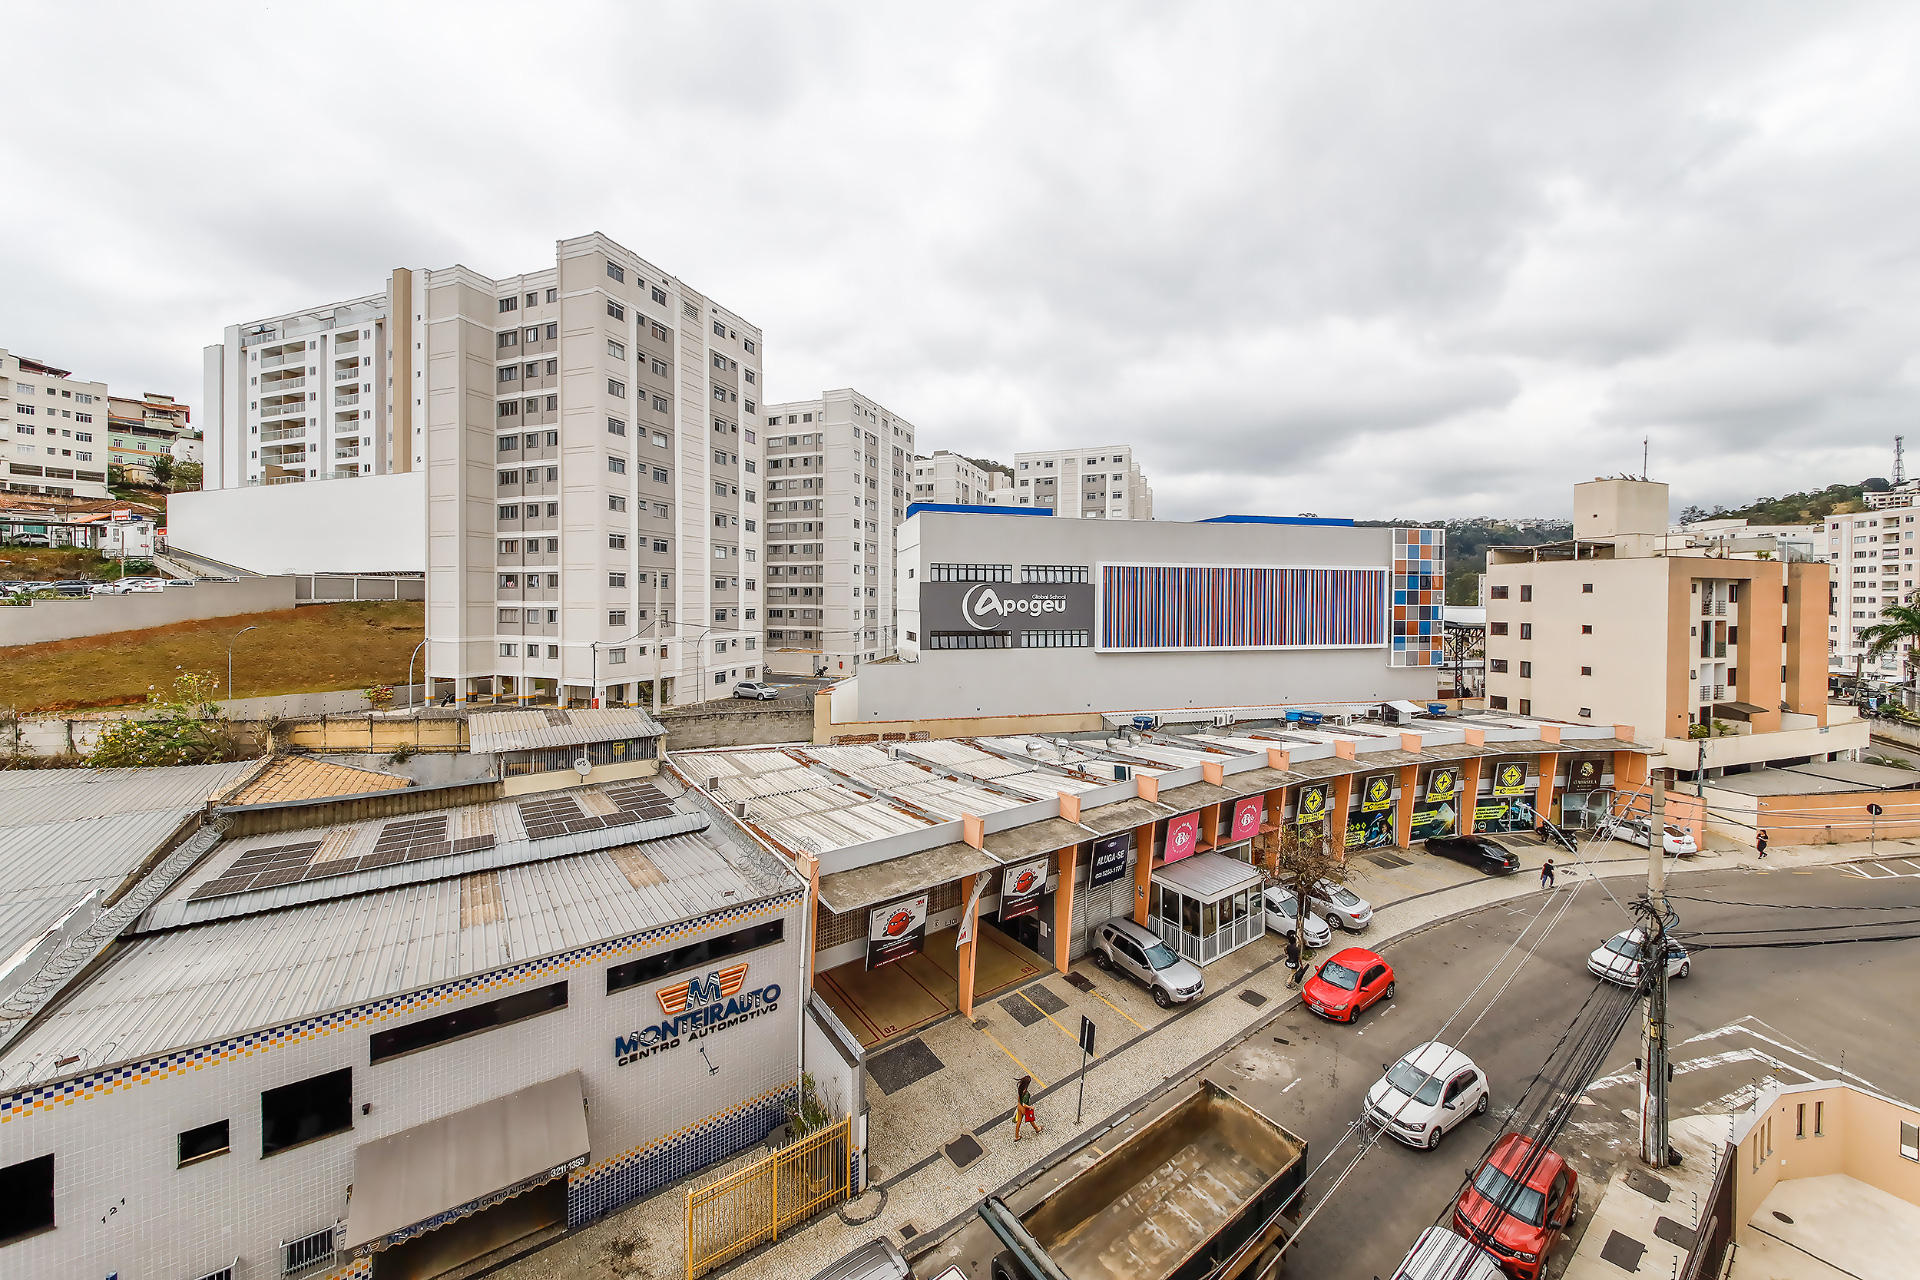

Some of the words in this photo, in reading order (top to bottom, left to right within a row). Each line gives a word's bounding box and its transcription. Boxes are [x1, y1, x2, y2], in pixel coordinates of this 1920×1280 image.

[974, 588, 1067, 617] Apogeu
[1096, 850, 1125, 866] ALUGA-SE
[615, 984, 782, 1057] MONTEIRAUTO
[618, 1038, 681, 1067] CENTRO
[688, 1003, 778, 1042] AUTOMOTIVO
[387, 1201, 480, 1245] MONTEIRAUTO
[482, 1189, 509, 1206] CENTRO
[508, 1173, 549, 1196] AUTOMOTIVO
[550, 1156, 585, 1178] 3211-1359
